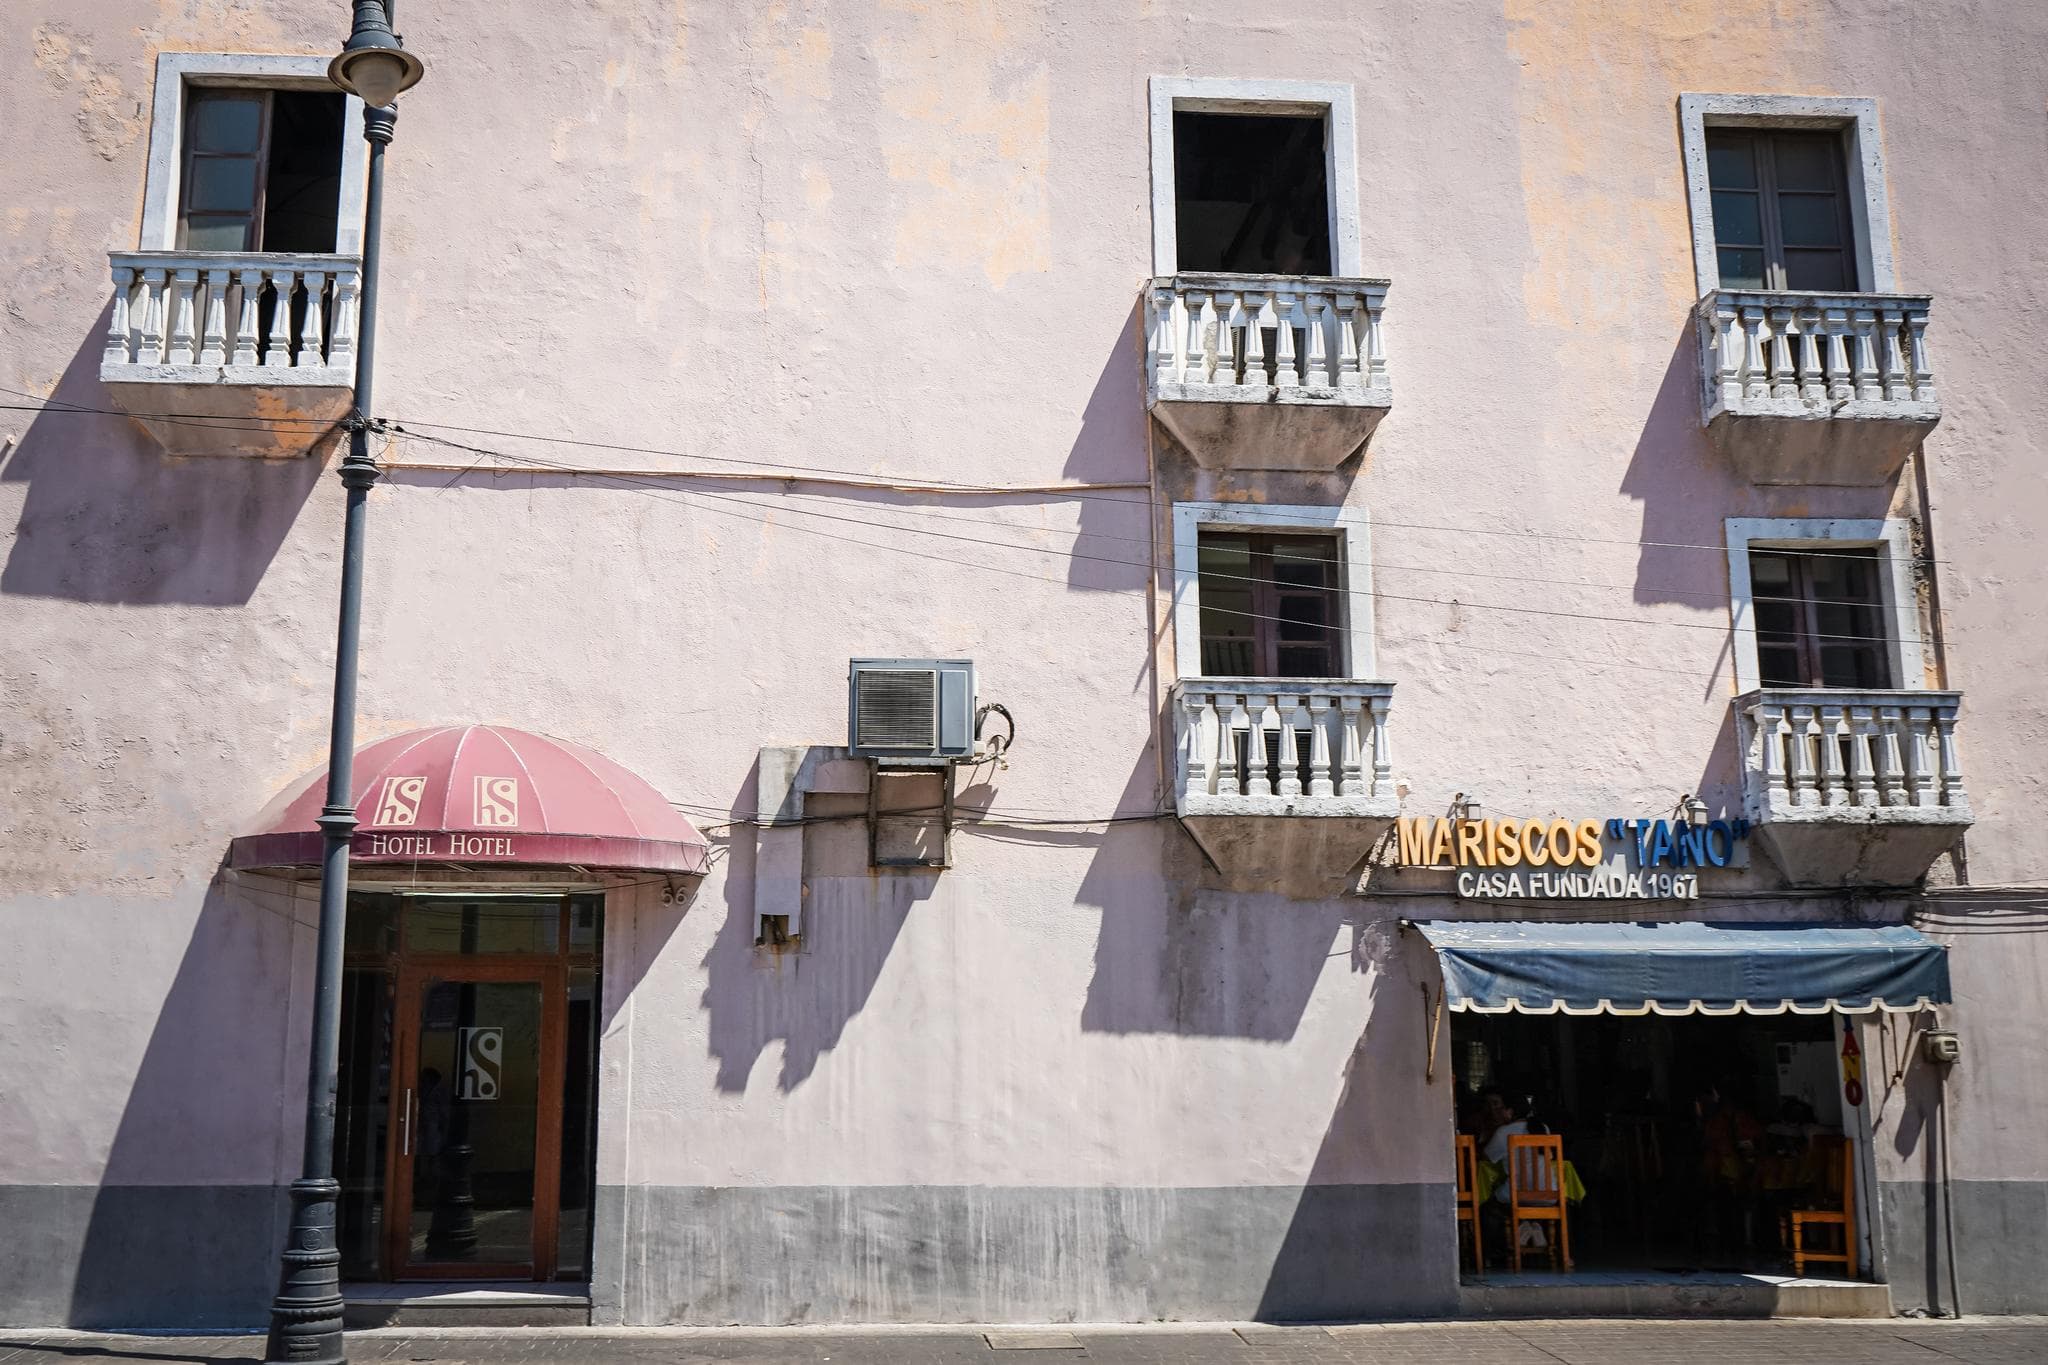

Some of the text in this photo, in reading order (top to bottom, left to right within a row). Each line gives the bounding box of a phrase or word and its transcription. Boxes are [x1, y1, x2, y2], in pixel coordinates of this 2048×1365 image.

[372, 834, 436, 855] HOTEL
[450, 834, 516, 856] HOTEL
[1397, 817, 1602, 867] MARISCOS
[1458, 871, 1699, 899] CASA FUNDADA 1967
